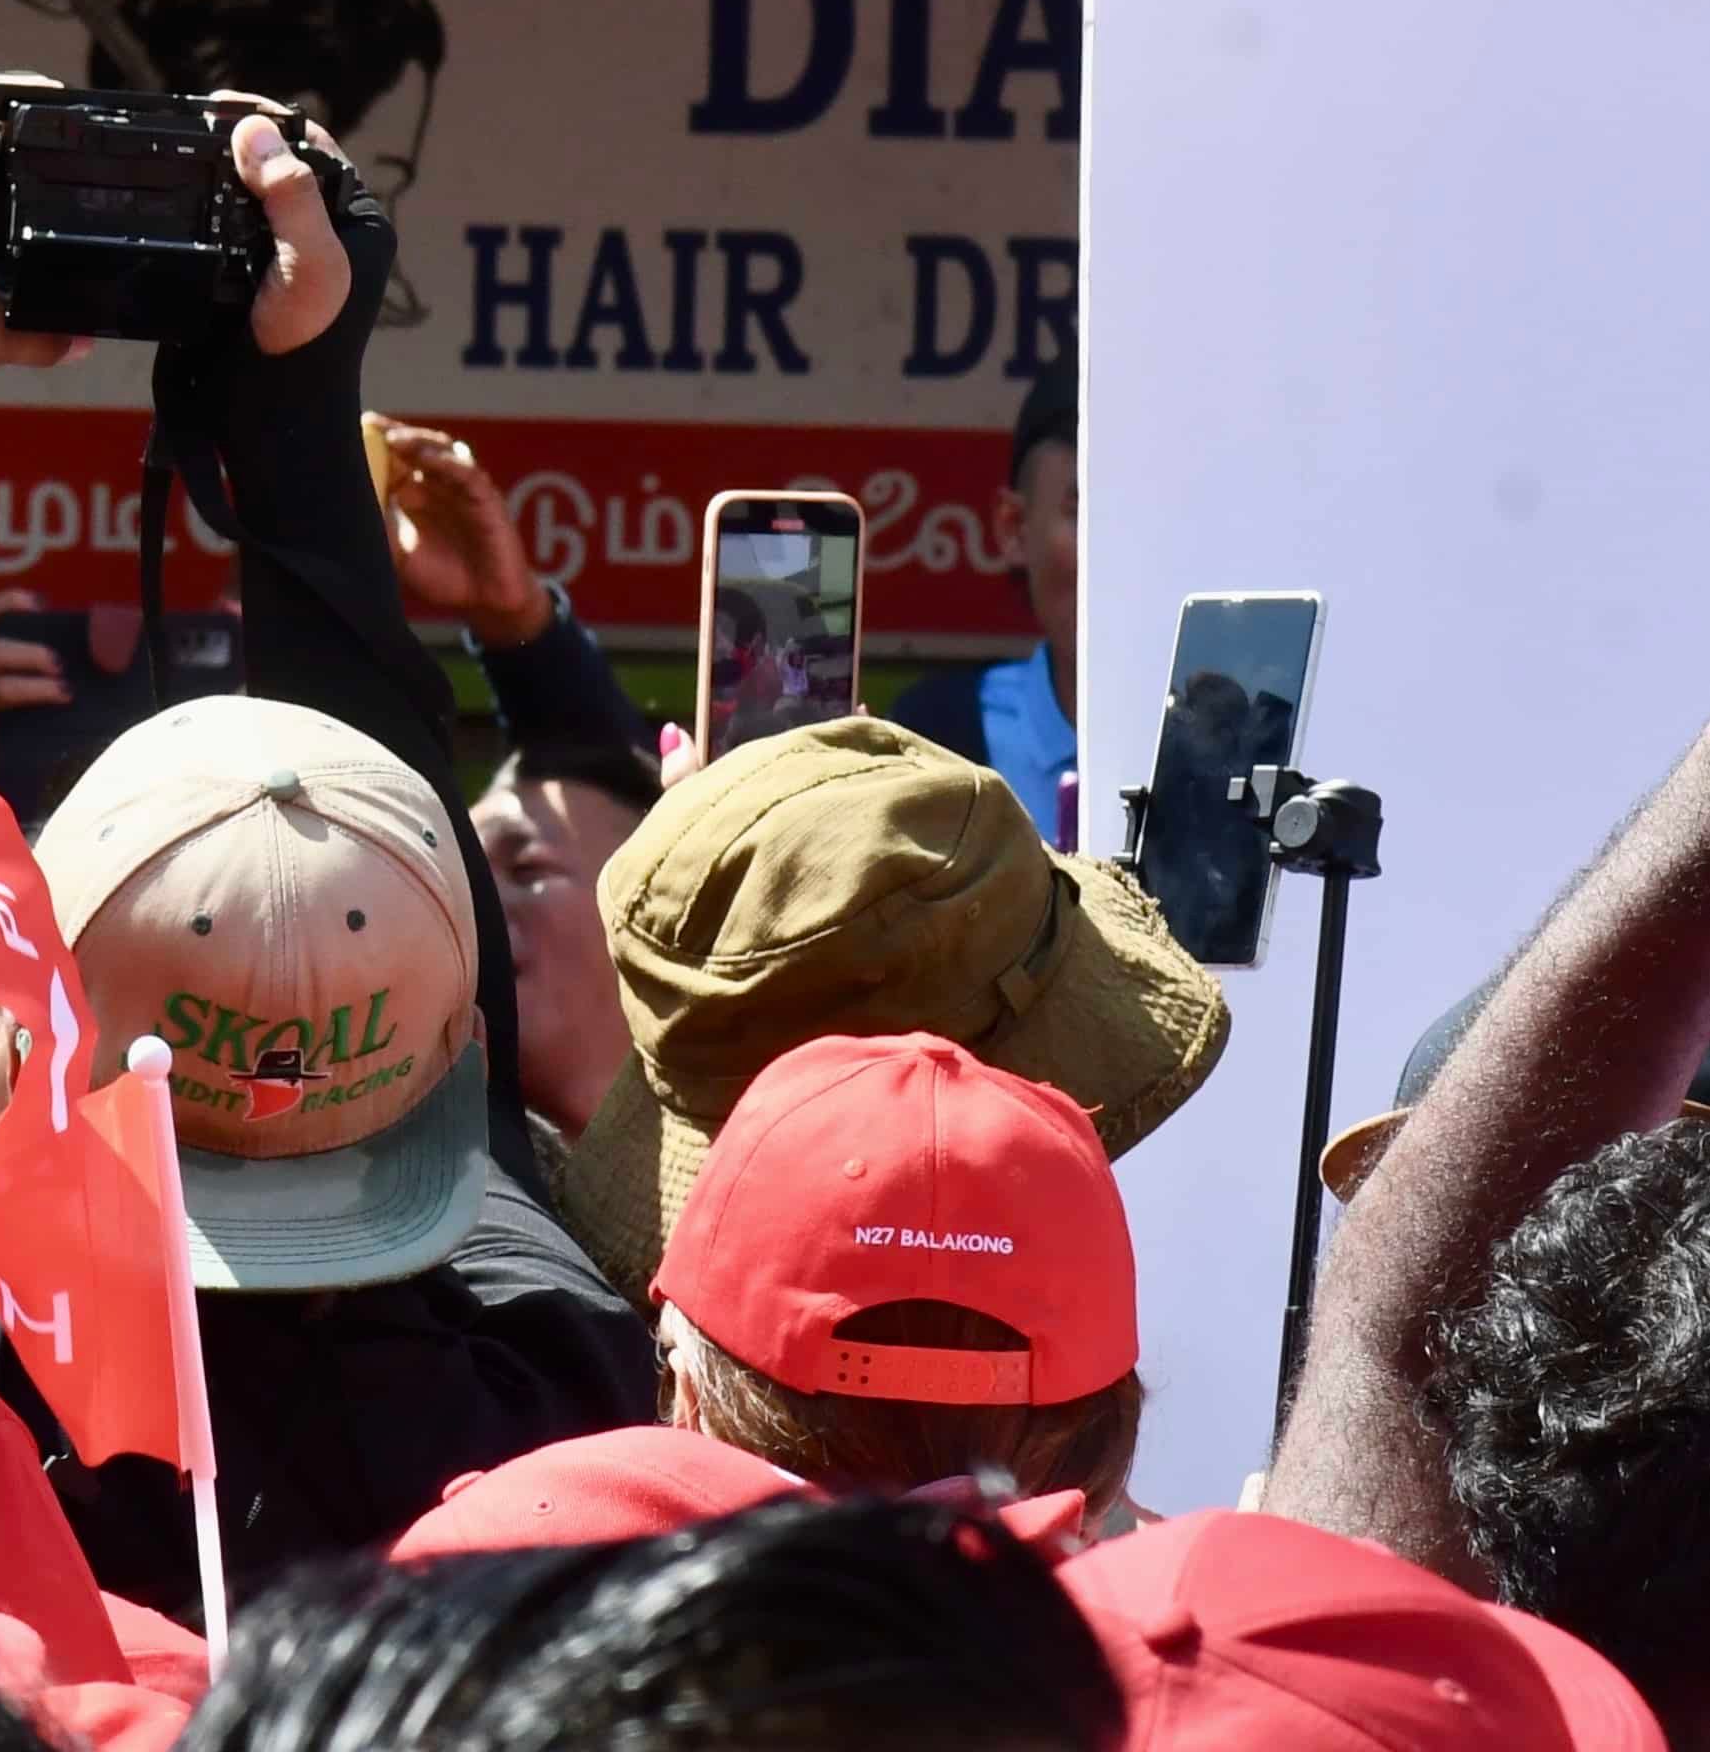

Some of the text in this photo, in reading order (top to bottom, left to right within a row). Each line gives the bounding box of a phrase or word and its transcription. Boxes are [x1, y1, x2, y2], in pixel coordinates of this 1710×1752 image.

[462, 224, 812, 378] HAIR
[154, 988, 397, 1073] SKOAL
[854, 1226, 1014, 1255] N27 BALAKONG
